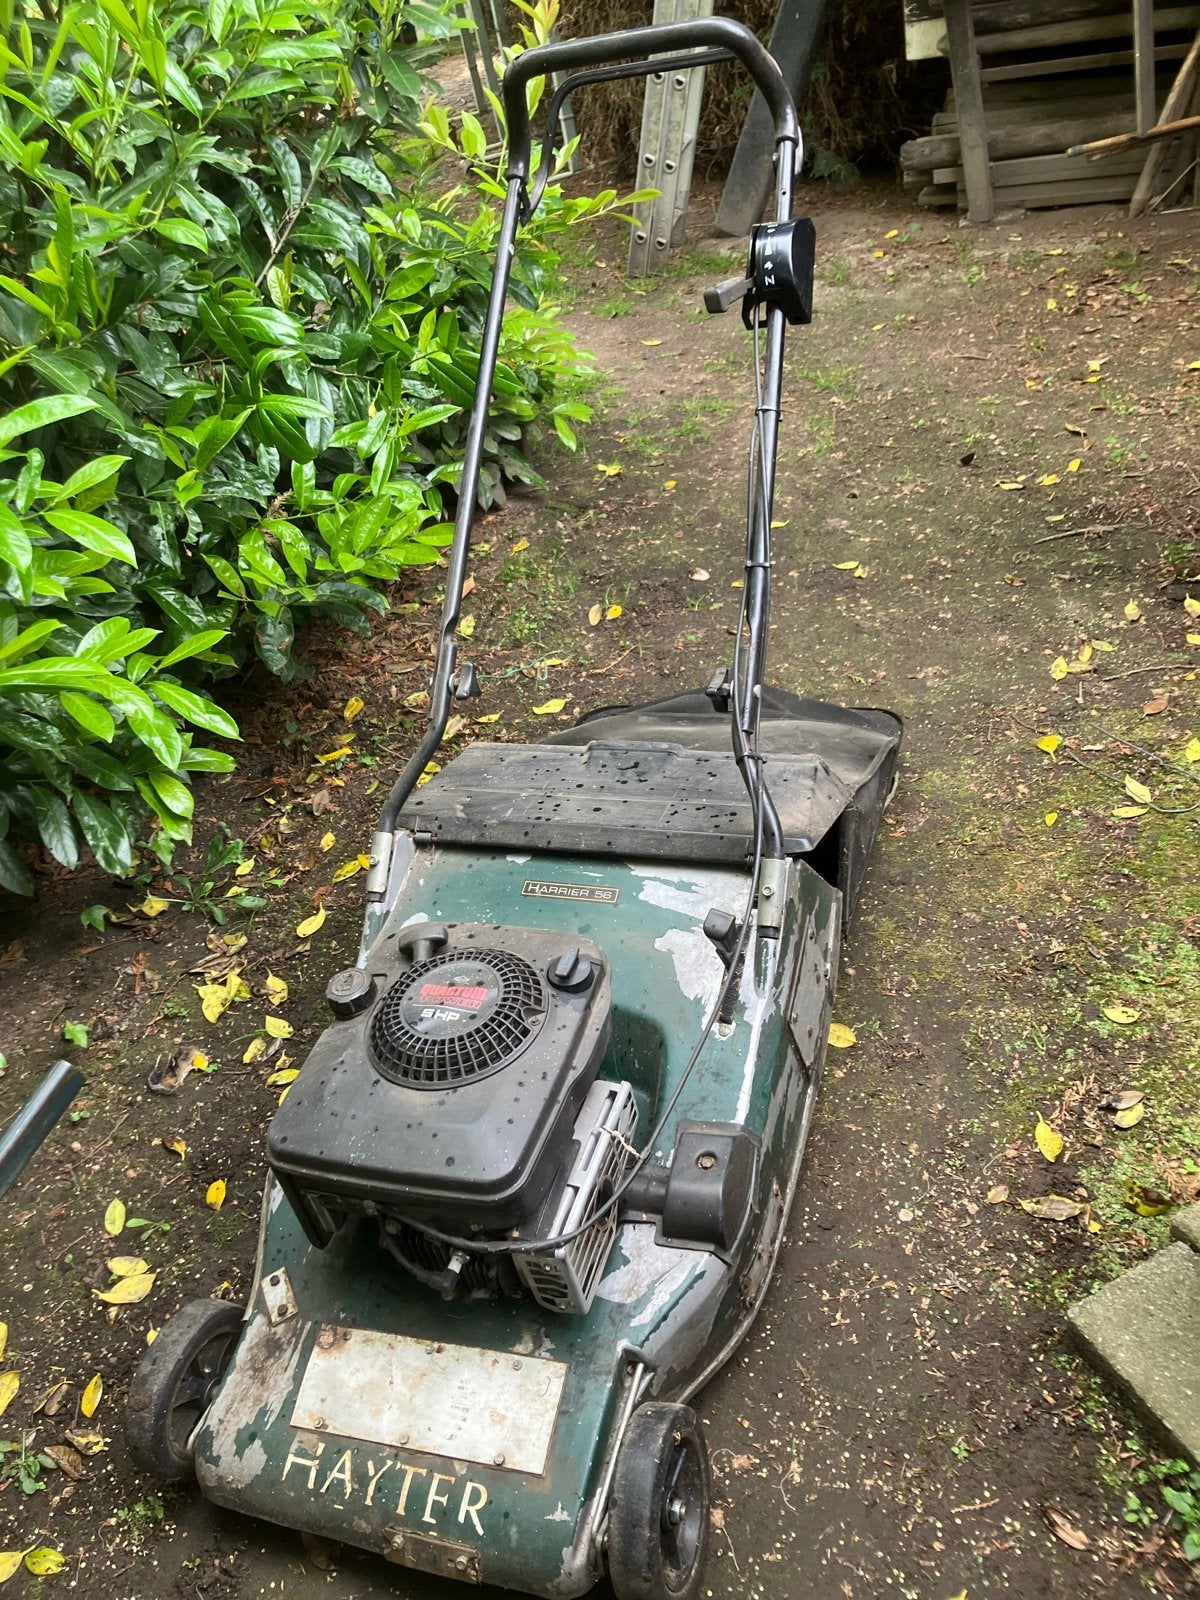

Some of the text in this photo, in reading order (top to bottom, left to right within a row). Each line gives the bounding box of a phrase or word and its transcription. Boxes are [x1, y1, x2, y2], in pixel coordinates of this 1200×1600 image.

[527, 883, 613, 900] HARRIER 56
[281, 1442, 488, 1537] HAYTER
